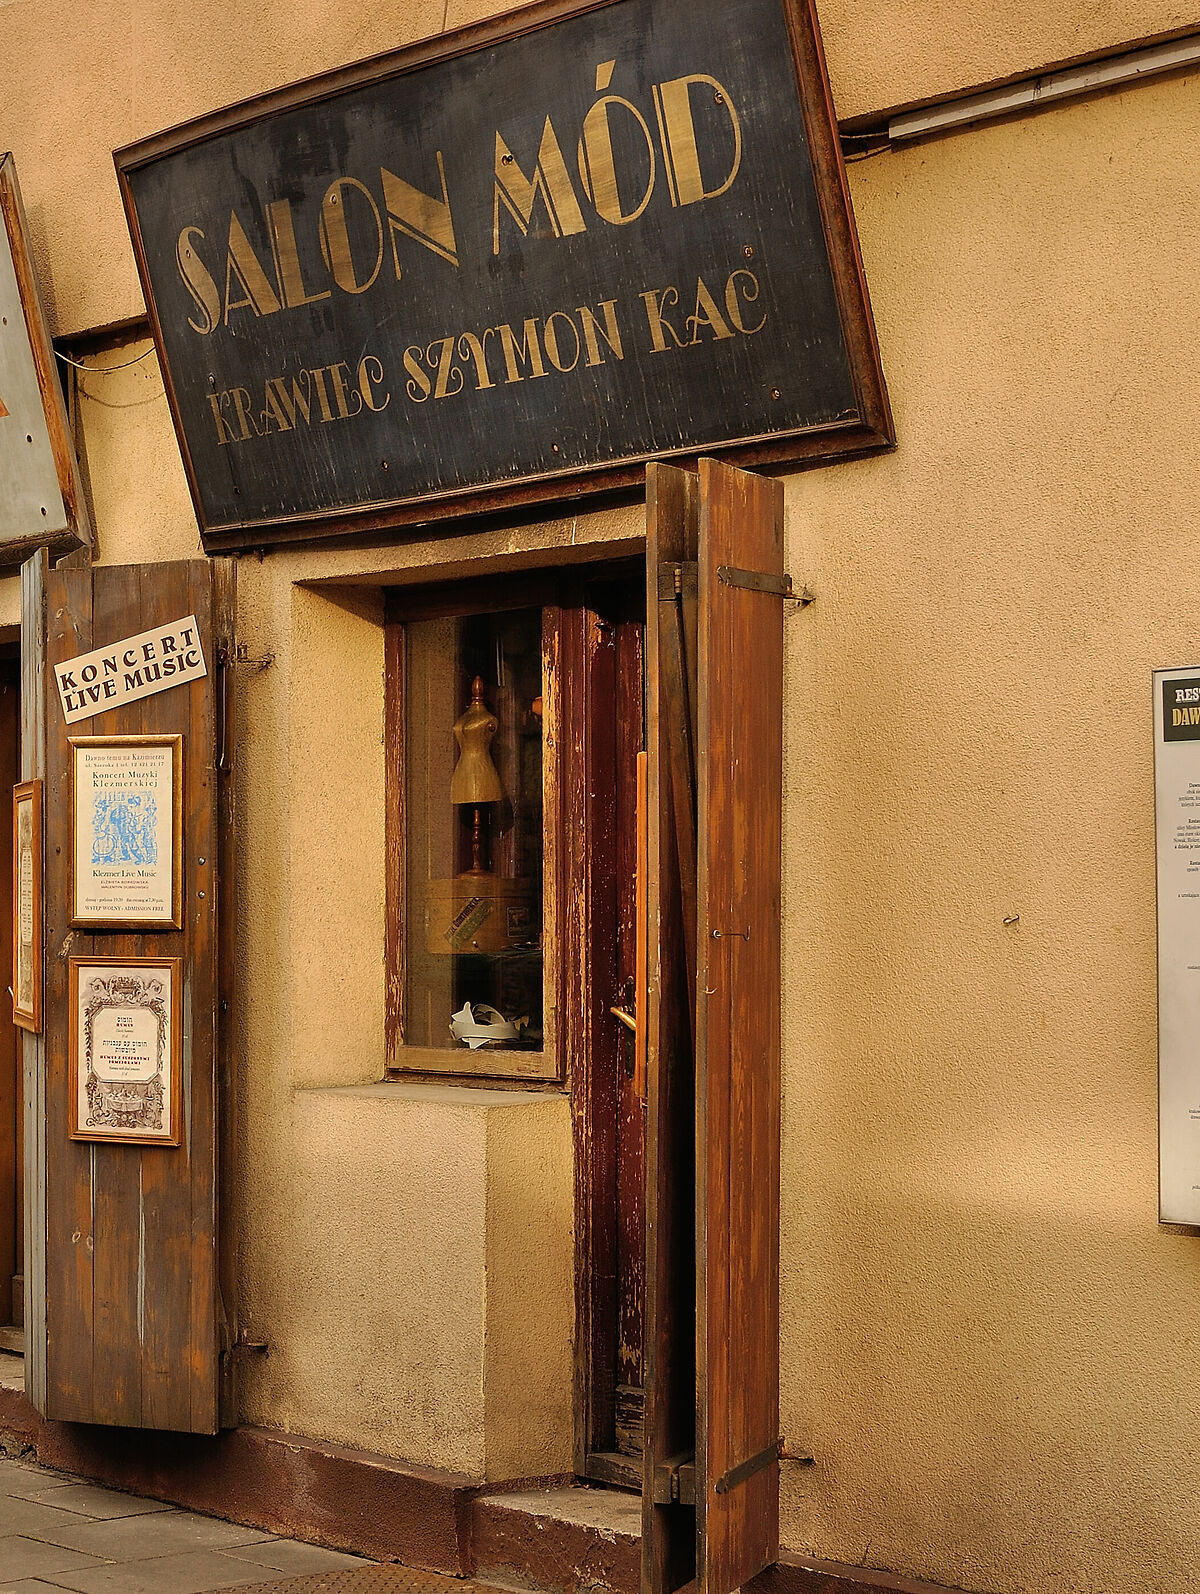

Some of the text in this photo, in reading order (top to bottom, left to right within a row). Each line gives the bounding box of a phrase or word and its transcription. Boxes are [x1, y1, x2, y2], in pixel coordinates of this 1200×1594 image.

[176, 60, 742, 335] SALON MÓD
[208, 269, 768, 446] KRAWIEC SZYMON KAC
[60, 628, 193, 691] KONCERT
[64, 650, 200, 712] LIVE MUSIC
[1175, 687, 1200, 703] RES
[92, 771, 158, 779] Koncert Muzyki
